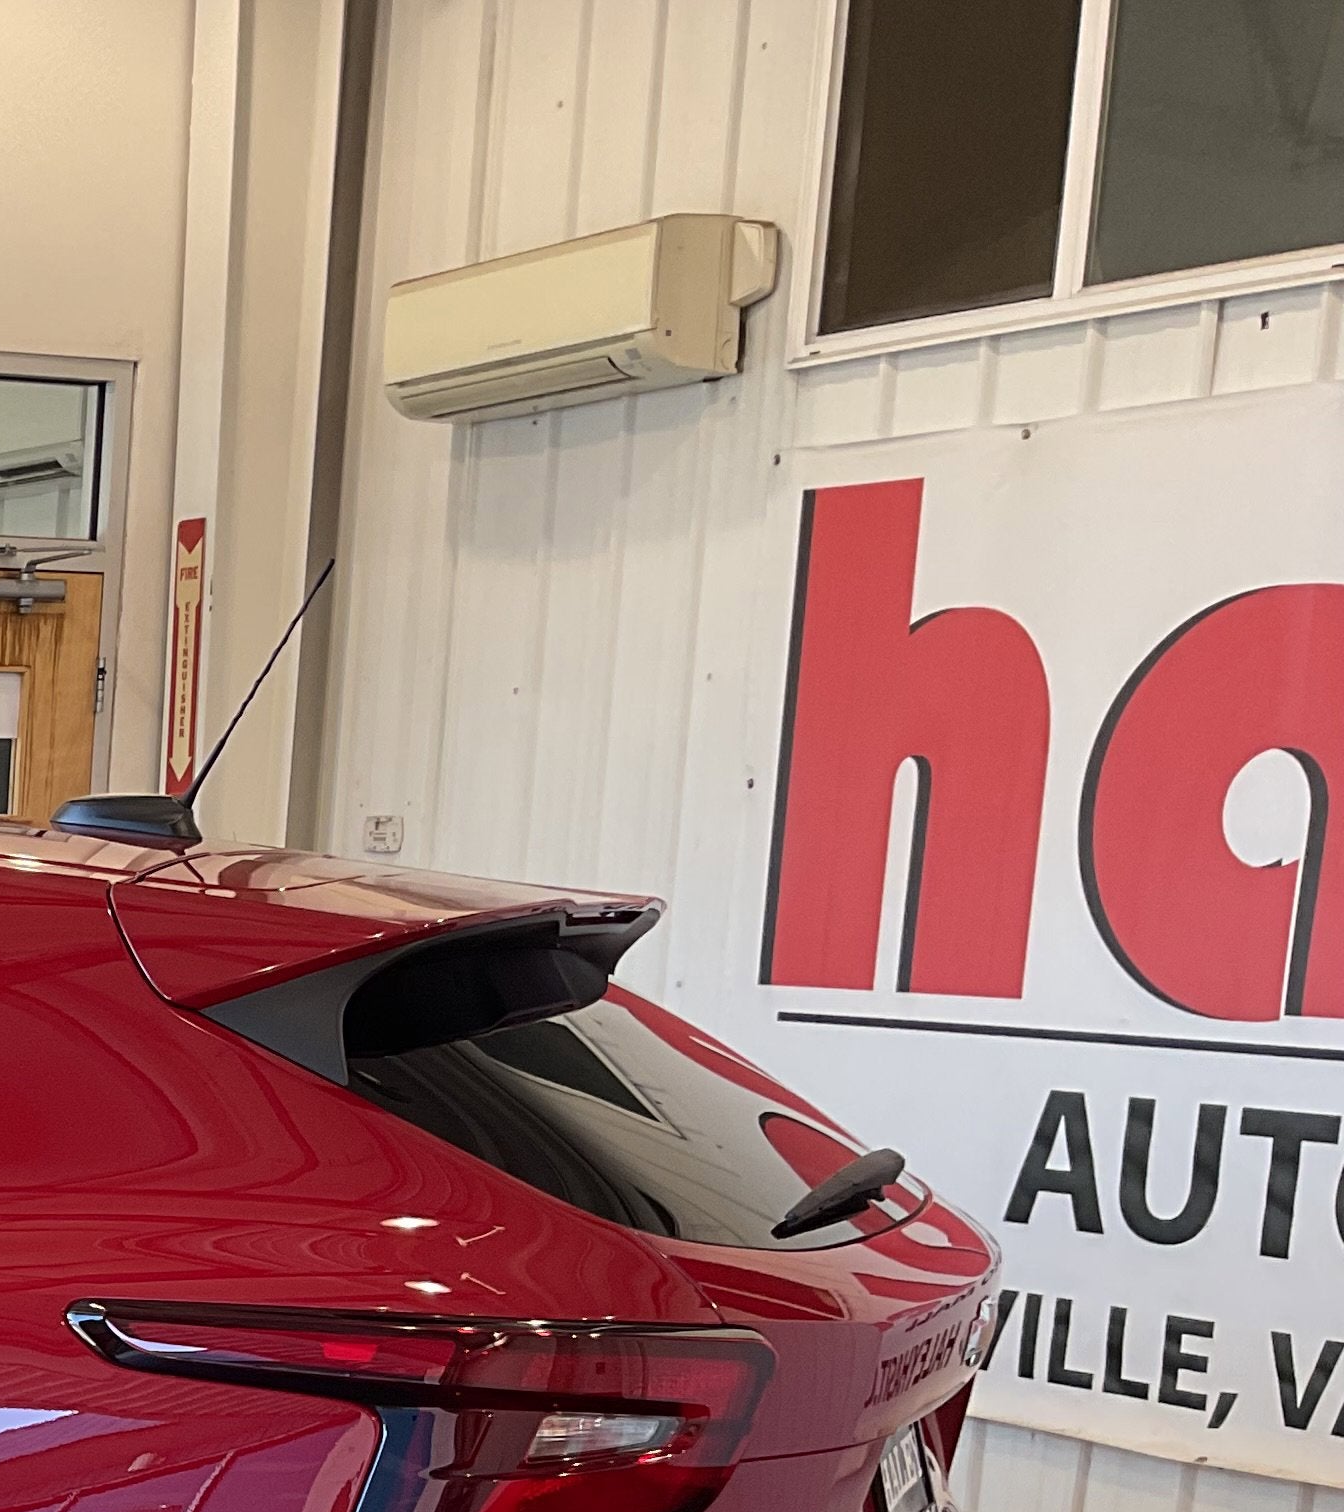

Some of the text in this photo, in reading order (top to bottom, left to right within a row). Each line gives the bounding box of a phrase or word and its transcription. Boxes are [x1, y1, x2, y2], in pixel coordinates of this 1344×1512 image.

[179, 566, 199, 581] FIRE
[178, 601, 191, 738] EXTINGUISHER
[1003, 1089, 1344, 1260] AUT
[1270, 1331, 1344, 1438] V
